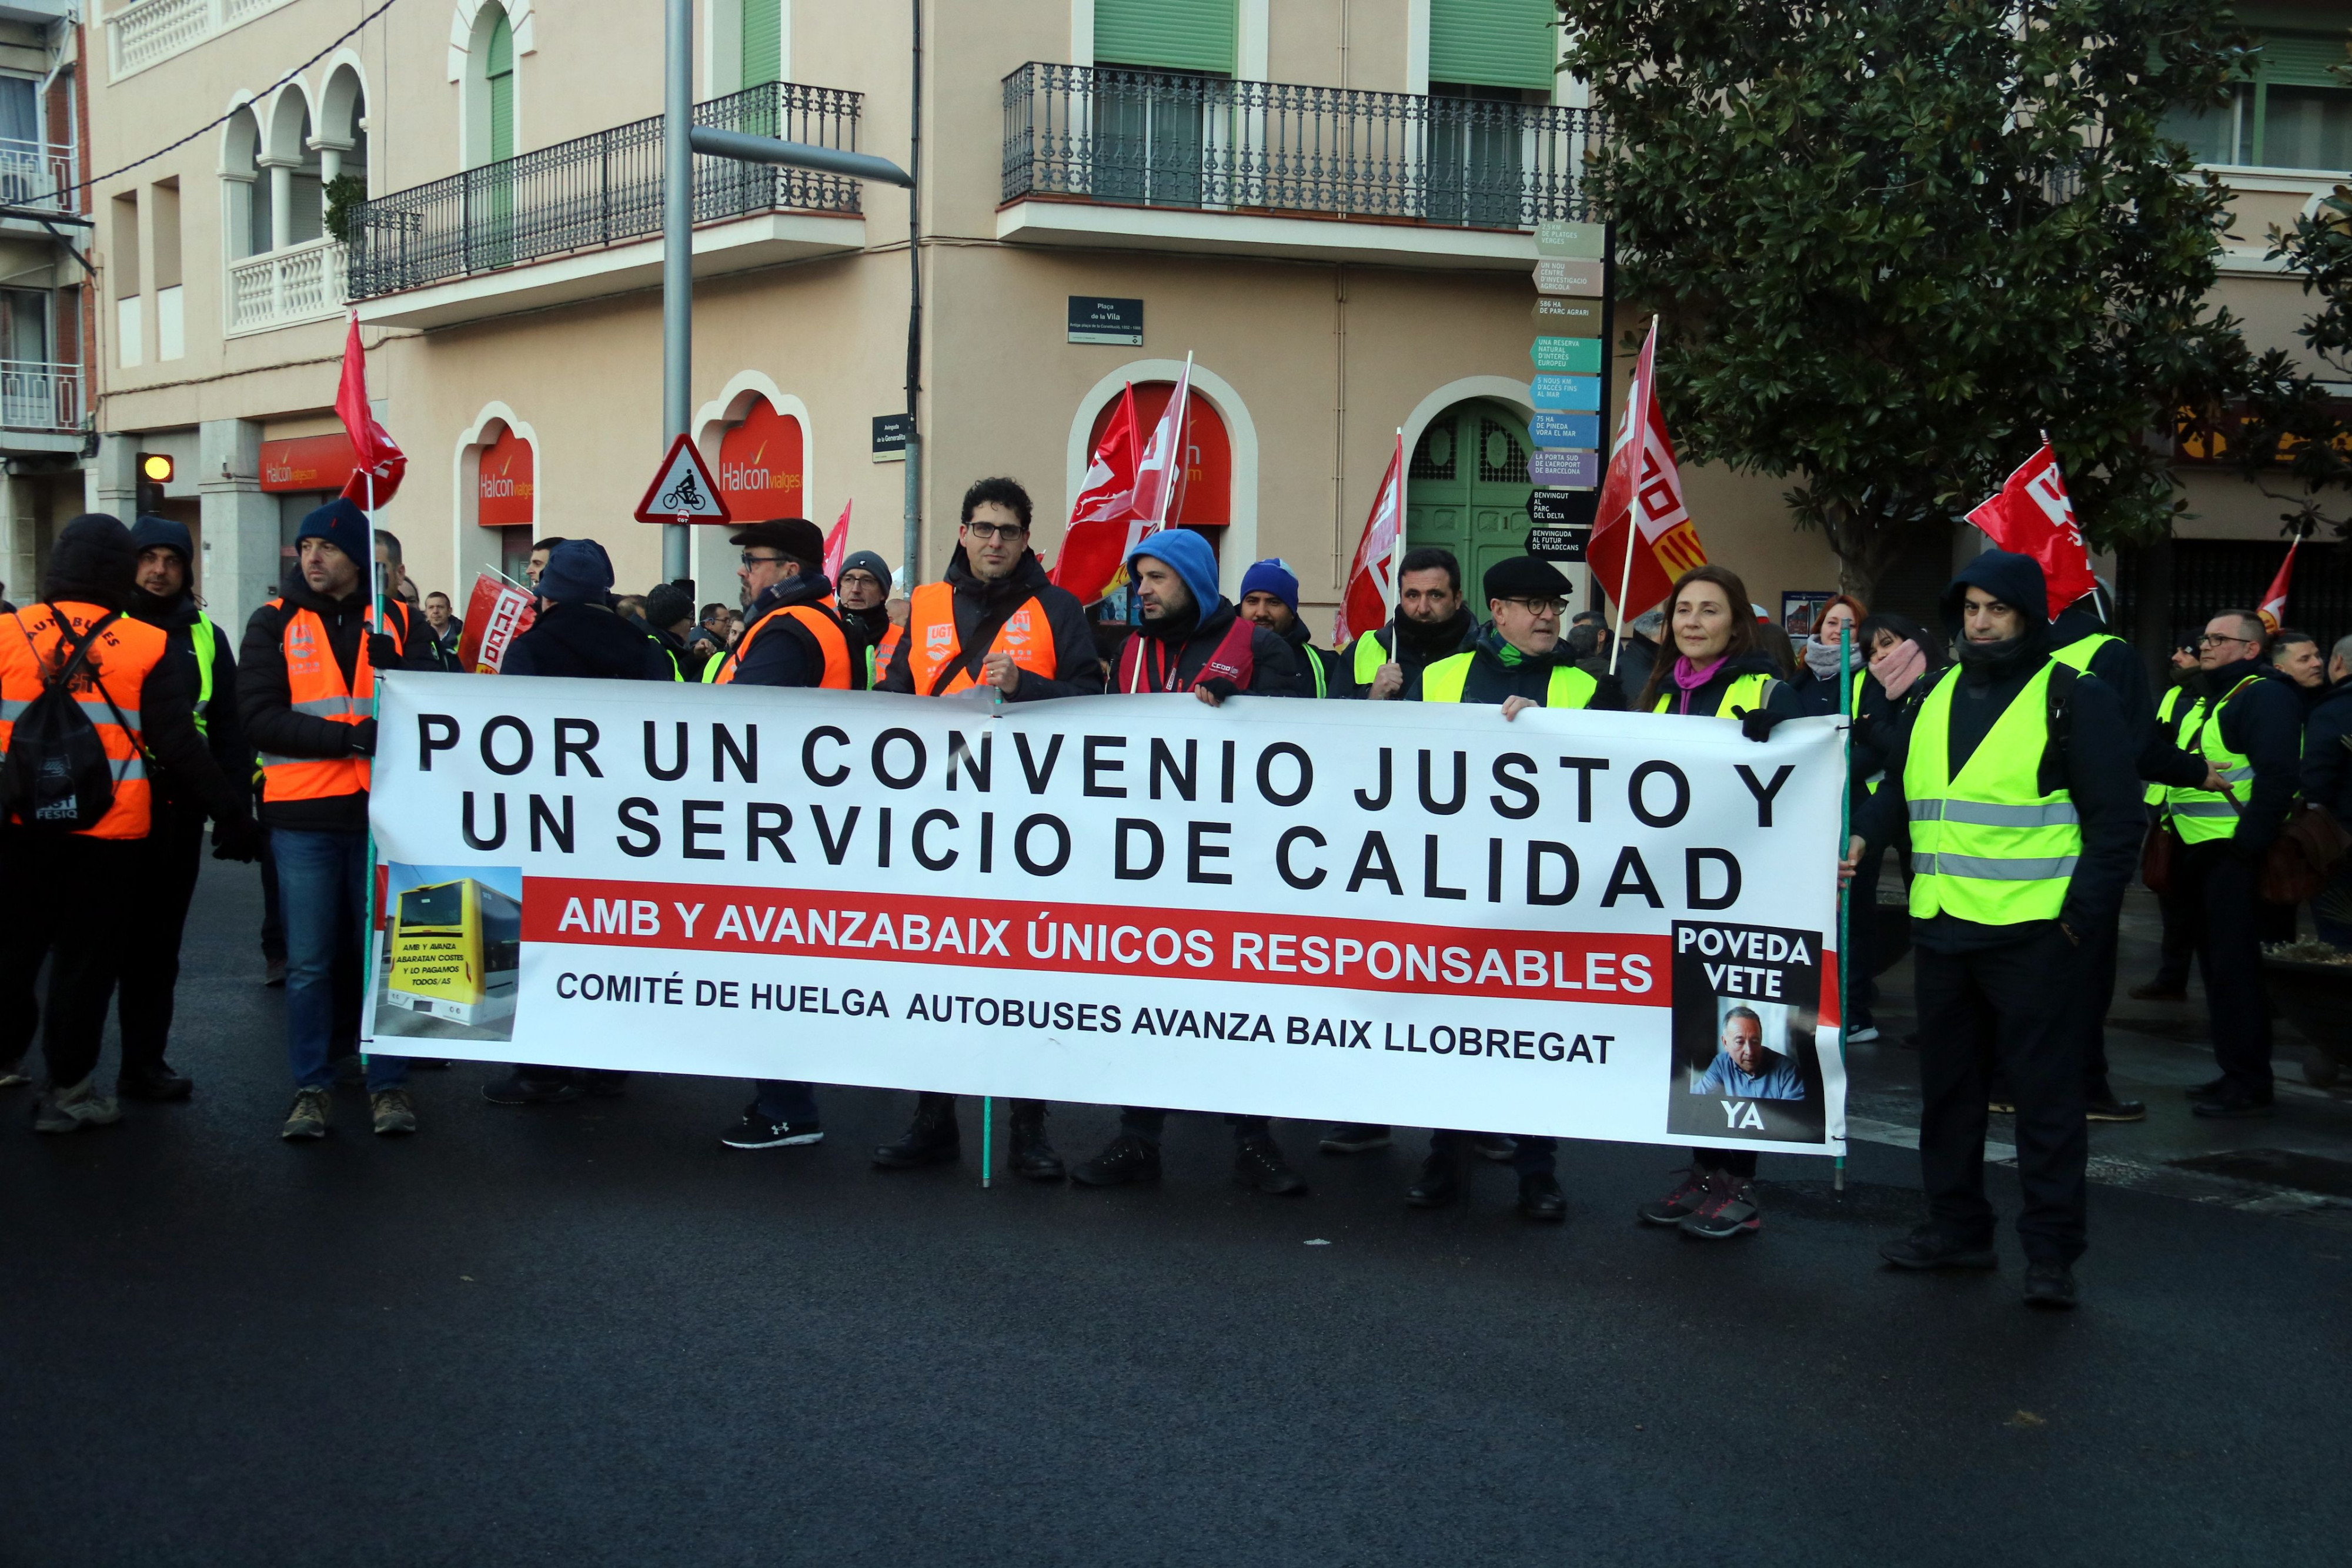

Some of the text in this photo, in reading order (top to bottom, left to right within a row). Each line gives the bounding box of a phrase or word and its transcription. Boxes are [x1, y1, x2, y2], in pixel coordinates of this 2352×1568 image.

[885, 433, 906, 442] Generalita
[266, 463, 291, 482] Halcon
[480, 474, 513, 498] Halcon
[723, 462, 769, 491] Halcon
[931, 626, 952, 639] UGT
[417, 713, 1796, 828] POR UN CONVENIO JUSTO Y
[462, 790, 1742, 911] UN SERVICIO DE CALIDAD
[557, 897, 1653, 994] AMB Y AVANZABAIX ÚNICOS RESPONSABLES
[1678, 927, 1812, 966] POVEDA
[1702, 962, 1783, 998] VETE
[556, 971, 1615, 1064] COMITÉ DE HUELGA AUTOBUSES AVANZA BAIX LLOBREGAT
[1720, 1100, 1765, 1130] YA
